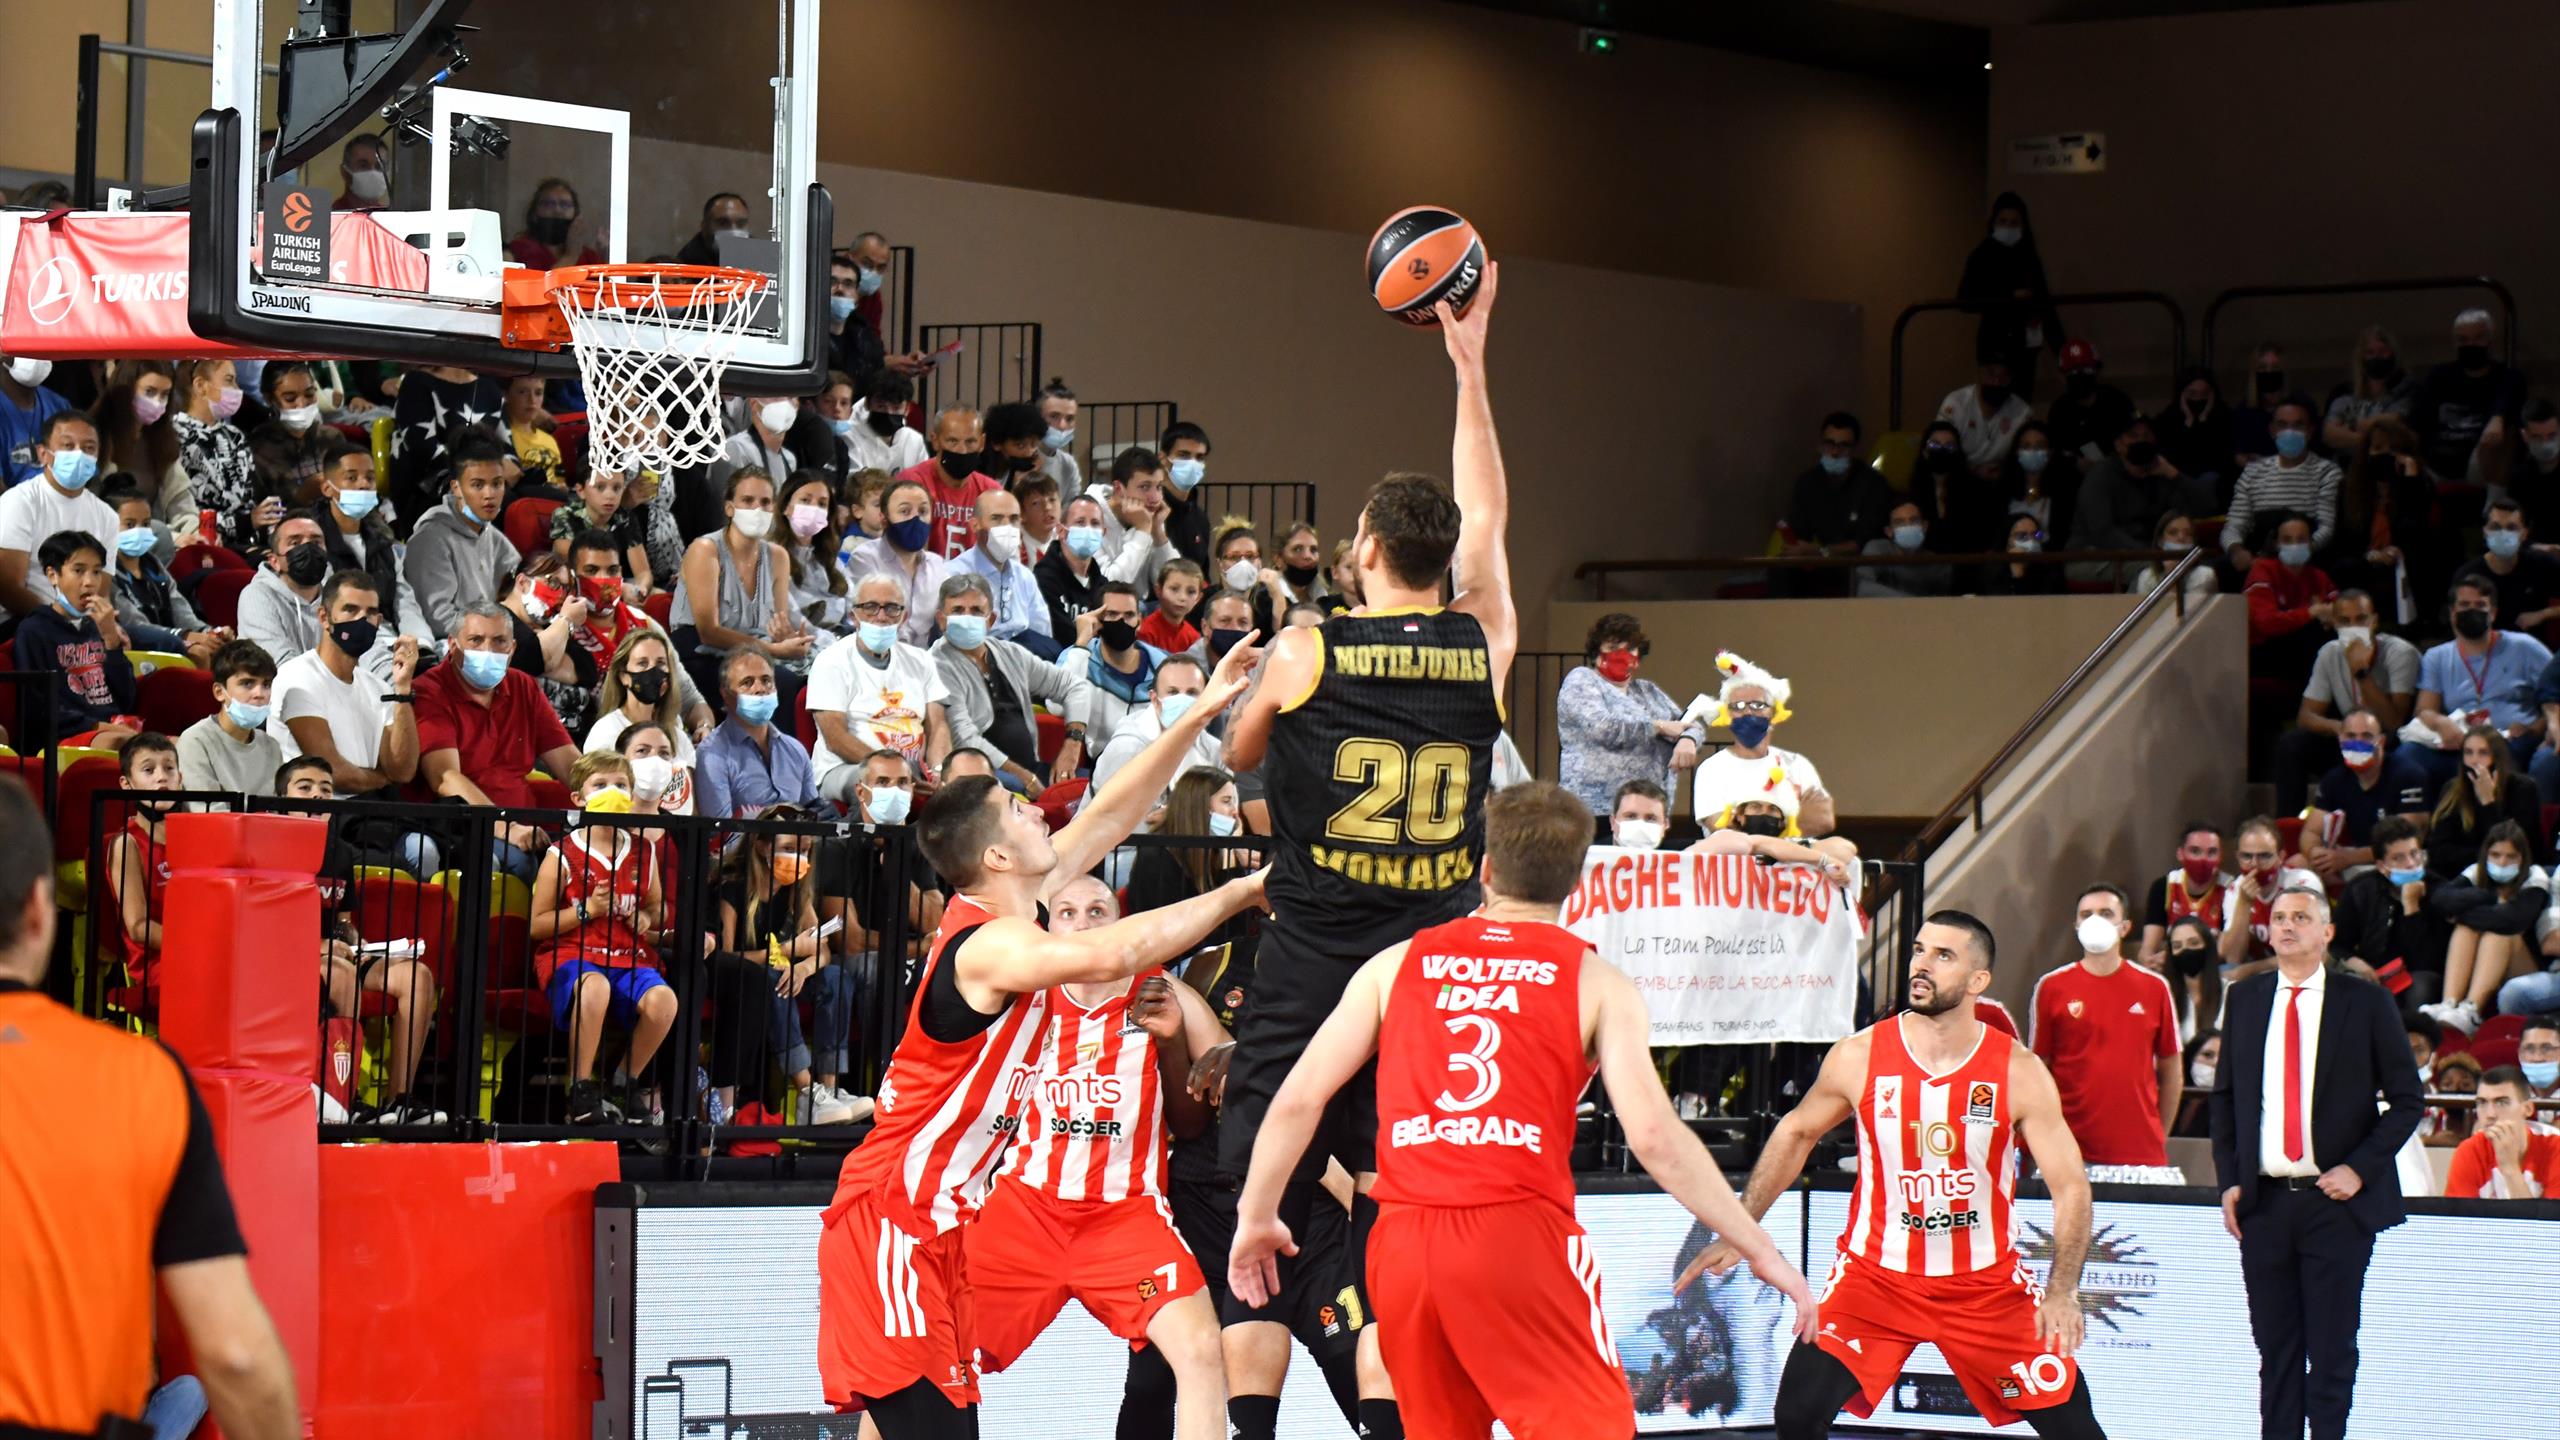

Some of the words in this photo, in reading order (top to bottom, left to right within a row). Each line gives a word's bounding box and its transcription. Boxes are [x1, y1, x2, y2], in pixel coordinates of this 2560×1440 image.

[272, 247, 321, 262] AIRLINES
[273, 233, 321, 250] TURKISH
[271, 260, 322, 276] EuroLeague
[91, 270, 188, 304] TURKIS
[251, 291, 312, 313] SPALDING
[1334, 644, 1488, 681] MOTIEJUNAS
[1325, 736, 1471, 845] 20
[1623, 936, 1645, 955] La
[1651, 936, 1700, 955] Team
[1769, 933, 1787, 955] là
[1421, 955, 1558, 985] WOLTERS
[1634, 975, 1686, 991] EMBLE
[1728, 975, 1747, 991] LA
[1434, 1014, 1501, 1113] 3
[1044, 1072, 1121, 1104] mts
[1051, 1116, 1122, 1137] SOCCER
[1392, 1114, 1542, 1154] BELGRADE
[1909, 1121, 1957, 1158] 10
[1898, 1168, 1976, 1197] mts
[1901, 1209, 1979, 1230] SOCCER
[1153, 1262, 1177, 1292] 7
[2087, 1271, 2157, 1287] RADIO
[1336, 1285, 1363, 1331] 1
[2010, 1354, 2067, 1396] 10
